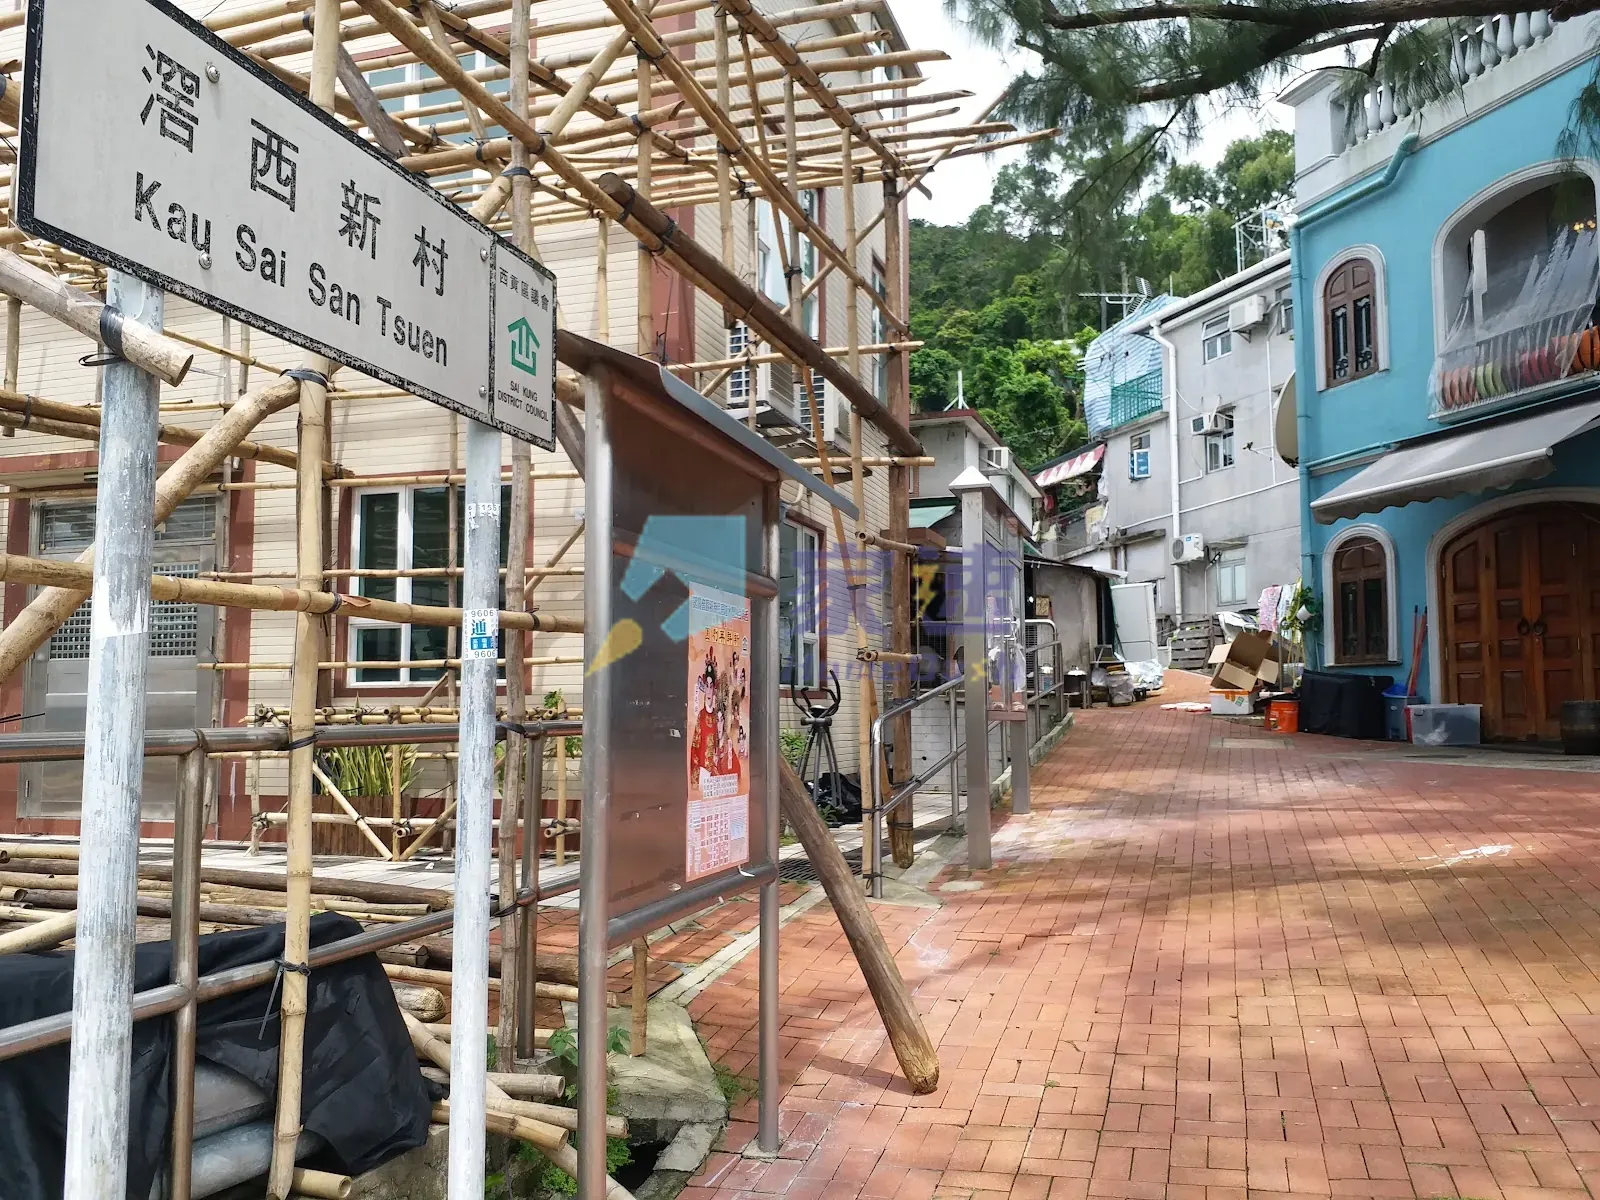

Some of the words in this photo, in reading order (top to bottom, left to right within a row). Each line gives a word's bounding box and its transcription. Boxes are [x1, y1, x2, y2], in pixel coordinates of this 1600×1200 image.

[140, 43, 448, 296] 滘西新村
[235, 223, 286, 287] Sai
[308, 262, 361, 325] San
[376, 294, 447, 367] Tsuen
[499, 266, 549, 312] 西貢區議會
[497, 390, 523, 410] DISTRICT
[525, 403, 549, 422] COUNCIL
[510, 380, 520, 394] SAI
[522, 386, 538, 402] KUNG
[470, 609, 495, 618] 9606
